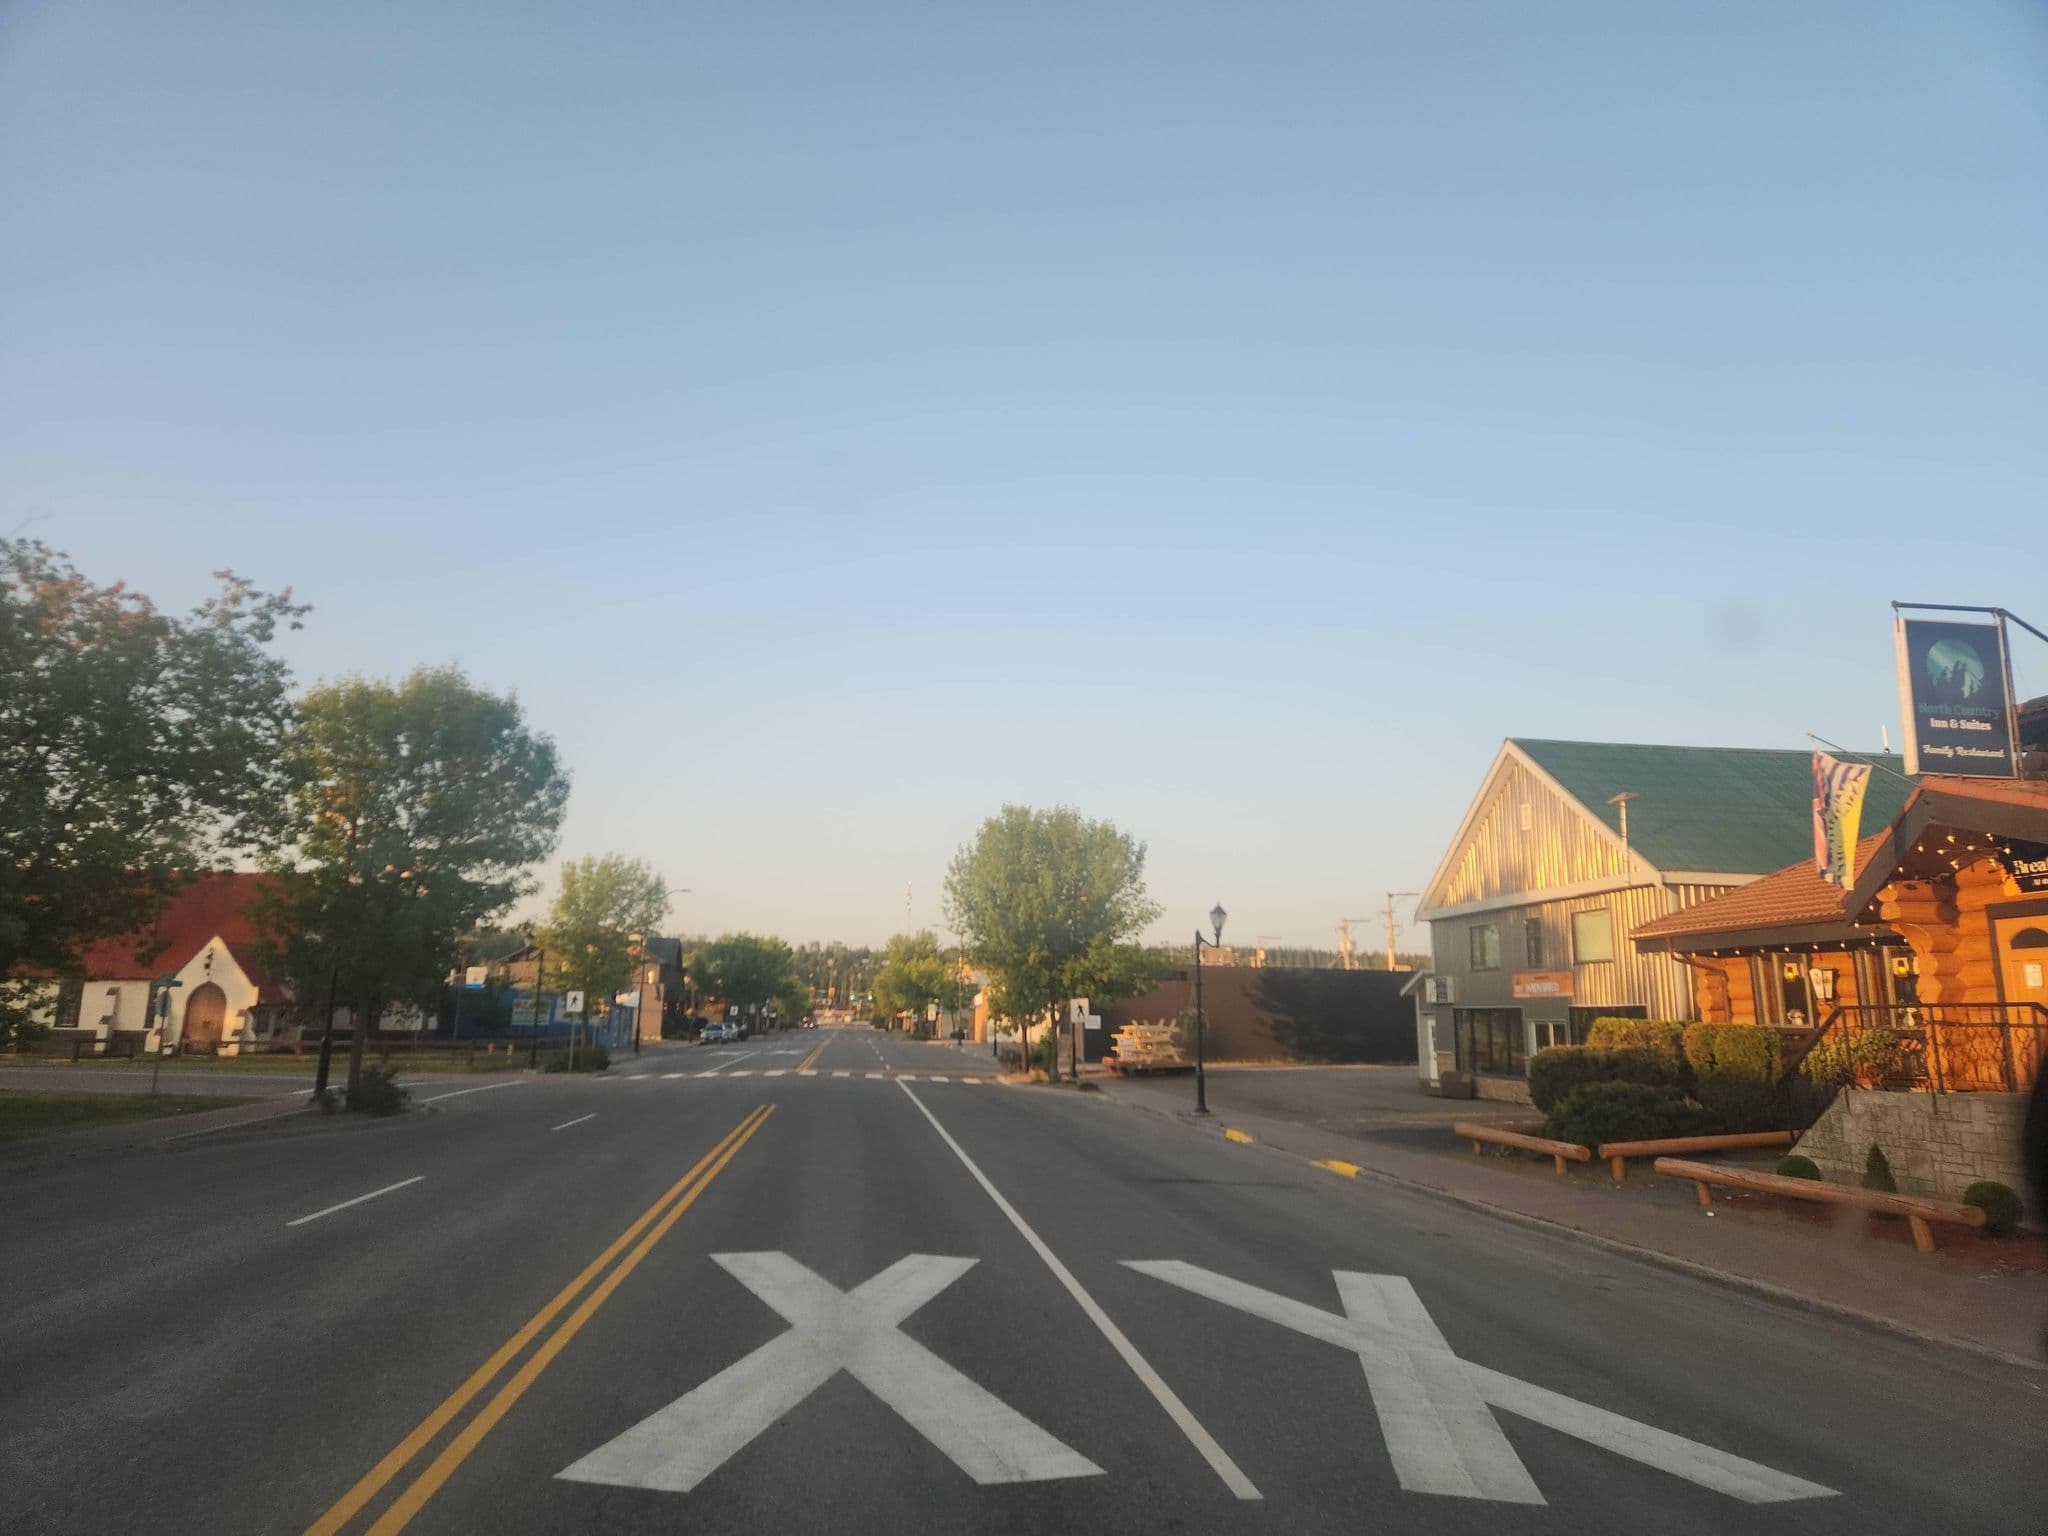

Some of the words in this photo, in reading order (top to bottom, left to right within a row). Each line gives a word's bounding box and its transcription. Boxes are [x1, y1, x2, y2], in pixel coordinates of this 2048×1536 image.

[1929, 717, 1949, 728] Inn
[1949, 719, 1959, 729] &
[1959, 719, 1992, 731] Suites
[2012, 857, 2048, 875] Brea
